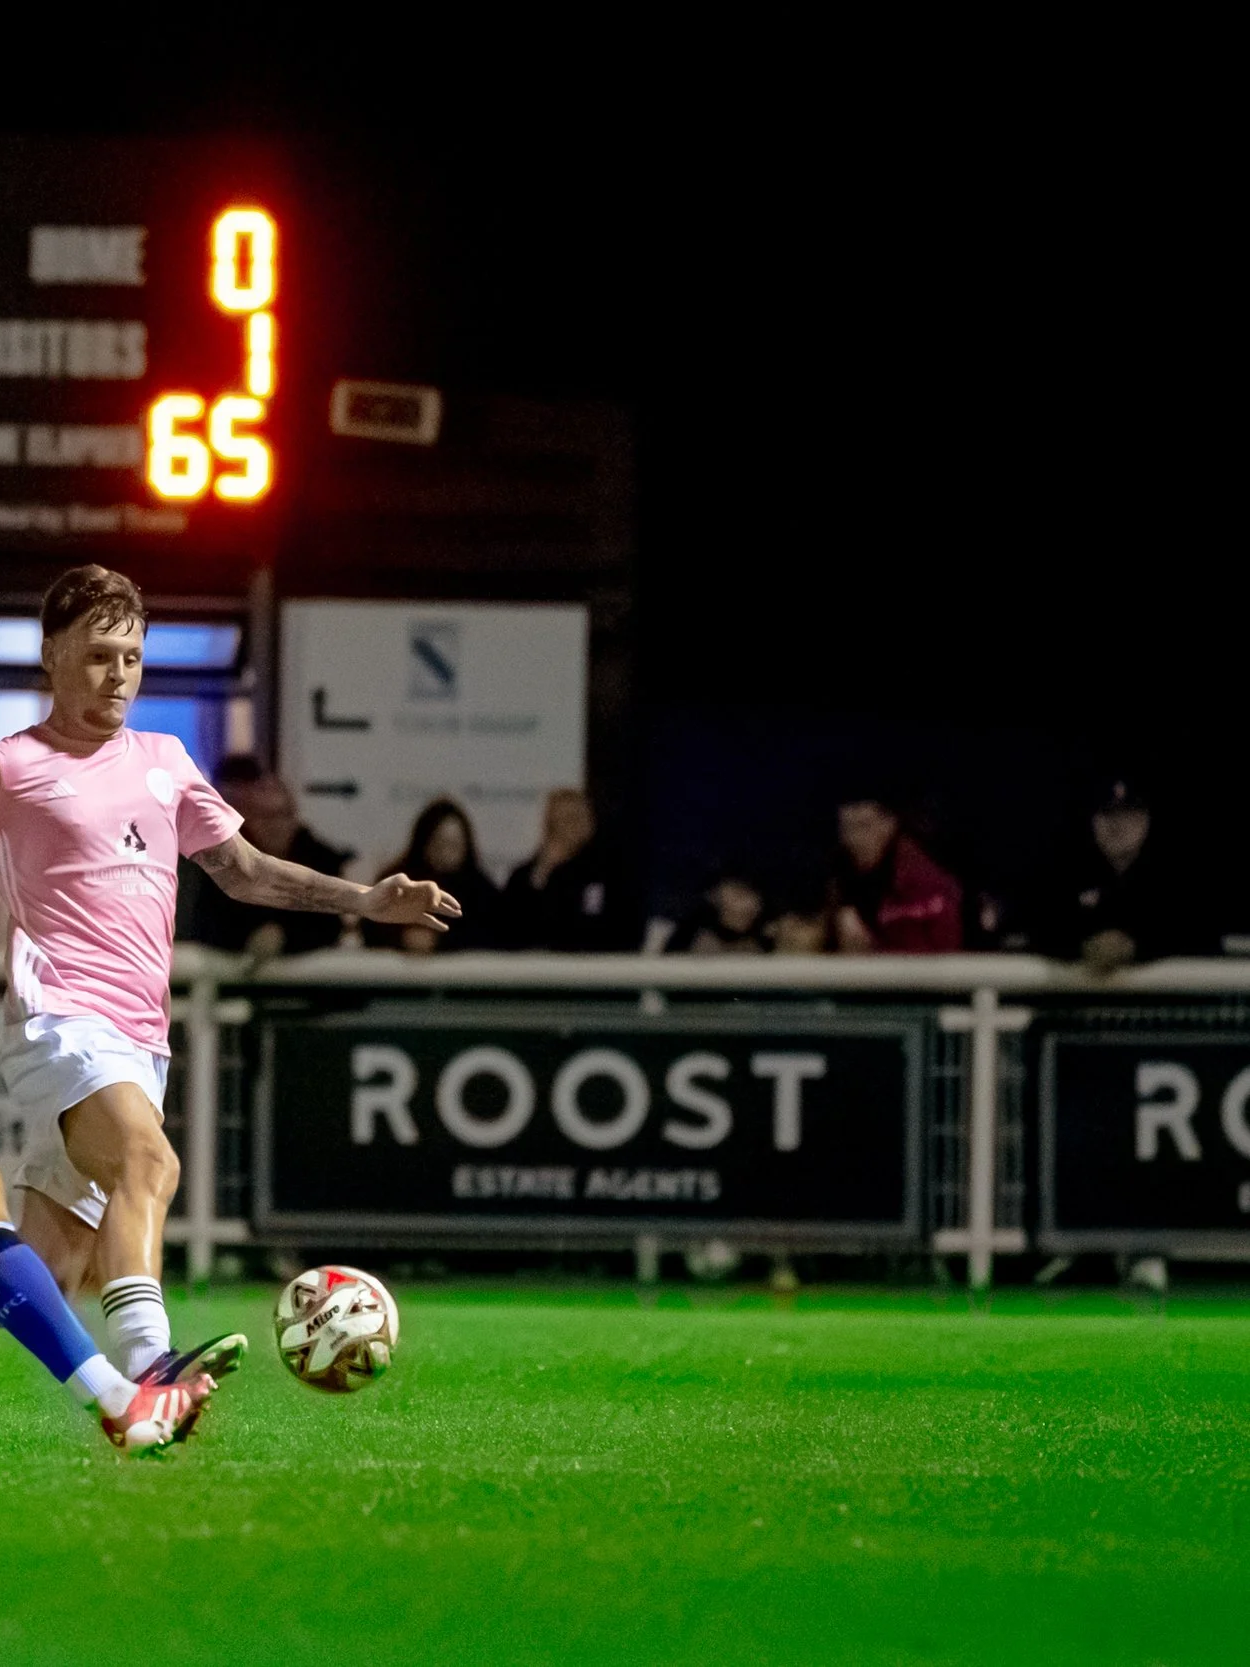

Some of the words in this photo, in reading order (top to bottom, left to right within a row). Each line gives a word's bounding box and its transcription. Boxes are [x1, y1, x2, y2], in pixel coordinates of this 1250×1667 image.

[213, 207, 275, 312] 0
[247, 311, 274, 397] 1
[148, 394, 271, 501] 65
[352, 1045, 827, 1152] ROOST
[451, 1163, 576, 1199] ESTATE
[583, 1166, 721, 1201] AGENTS
